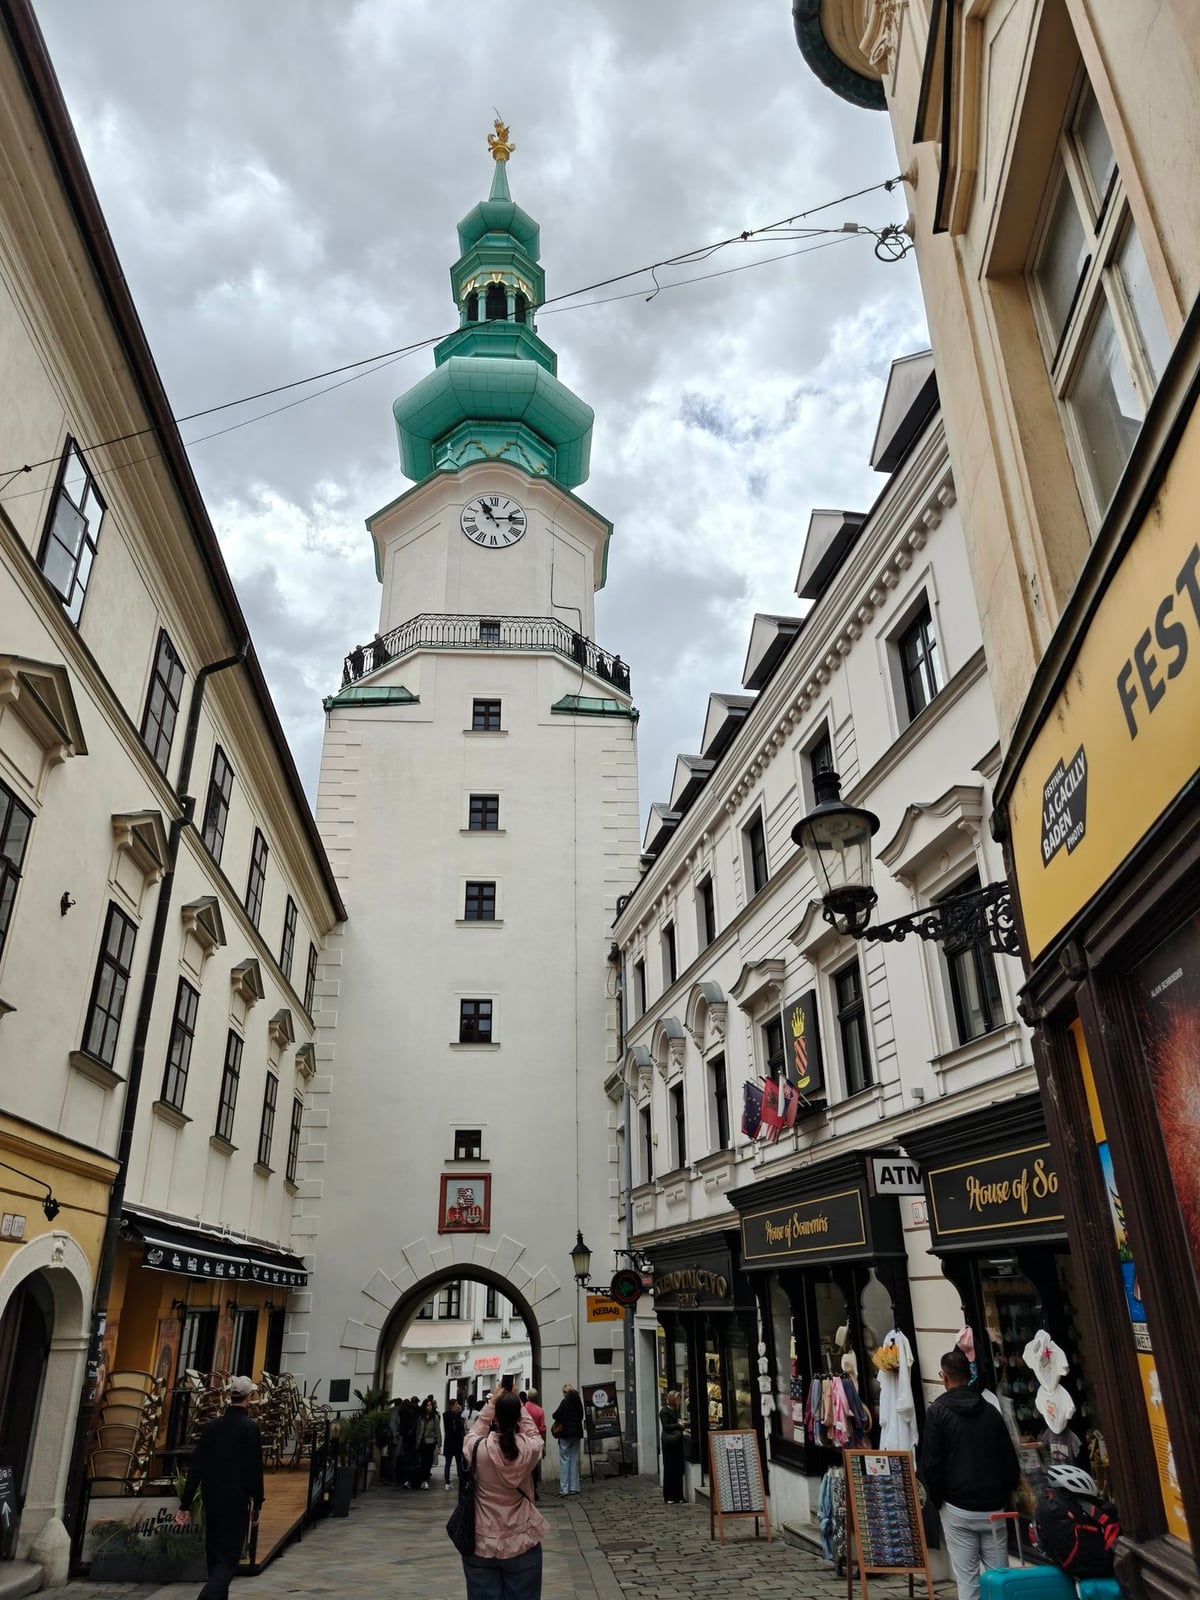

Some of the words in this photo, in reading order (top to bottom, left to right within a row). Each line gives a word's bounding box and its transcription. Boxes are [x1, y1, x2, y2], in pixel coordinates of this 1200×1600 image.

[1116, 542, 1200, 742] FEST
[1043, 803, 1056, 830] LA
[1054, 752, 1085, 813] GACILLY
[1044, 766, 1065, 801] FESTIVAL
[1043, 807, 1073, 860] BADEN
[1066, 821, 1084, 849] PHOTO
[880, 1166, 922, 1185] ATM
[965, 1175, 1011, 1212] House
[1012, 1168, 1030, 1214] of
[1033, 1158, 1058, 1198] So
[765, 1220, 784, 1245] House
[784, 1218, 792, 1249] of
[592, 1306, 620, 1317] KEBAB
